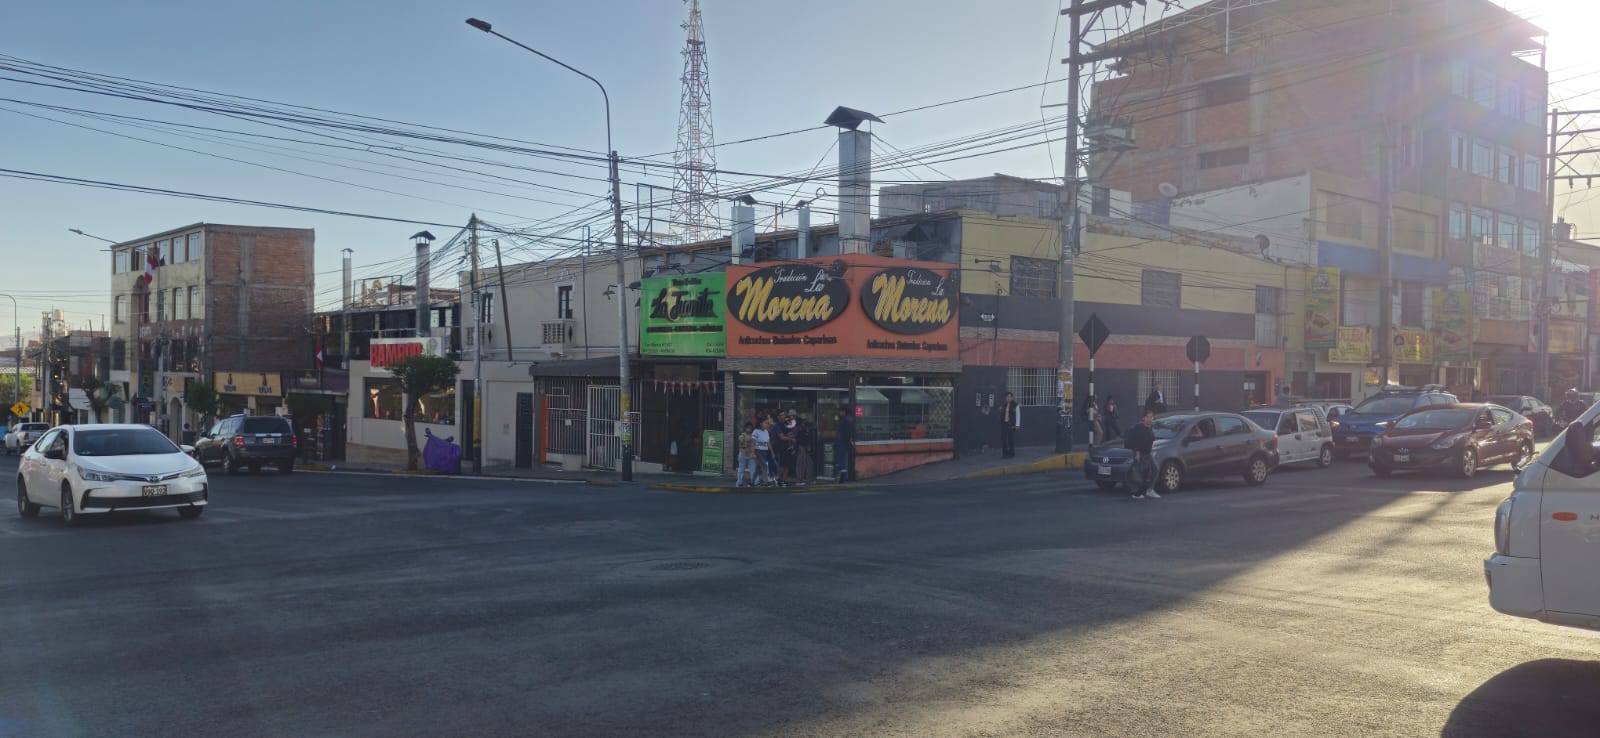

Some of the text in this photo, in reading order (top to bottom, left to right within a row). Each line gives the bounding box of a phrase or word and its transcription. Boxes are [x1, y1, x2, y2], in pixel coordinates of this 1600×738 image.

[736, 276, 833, 322] Morena
[804, 269, 825, 293] La
[872, 273, 951, 324] Morena
